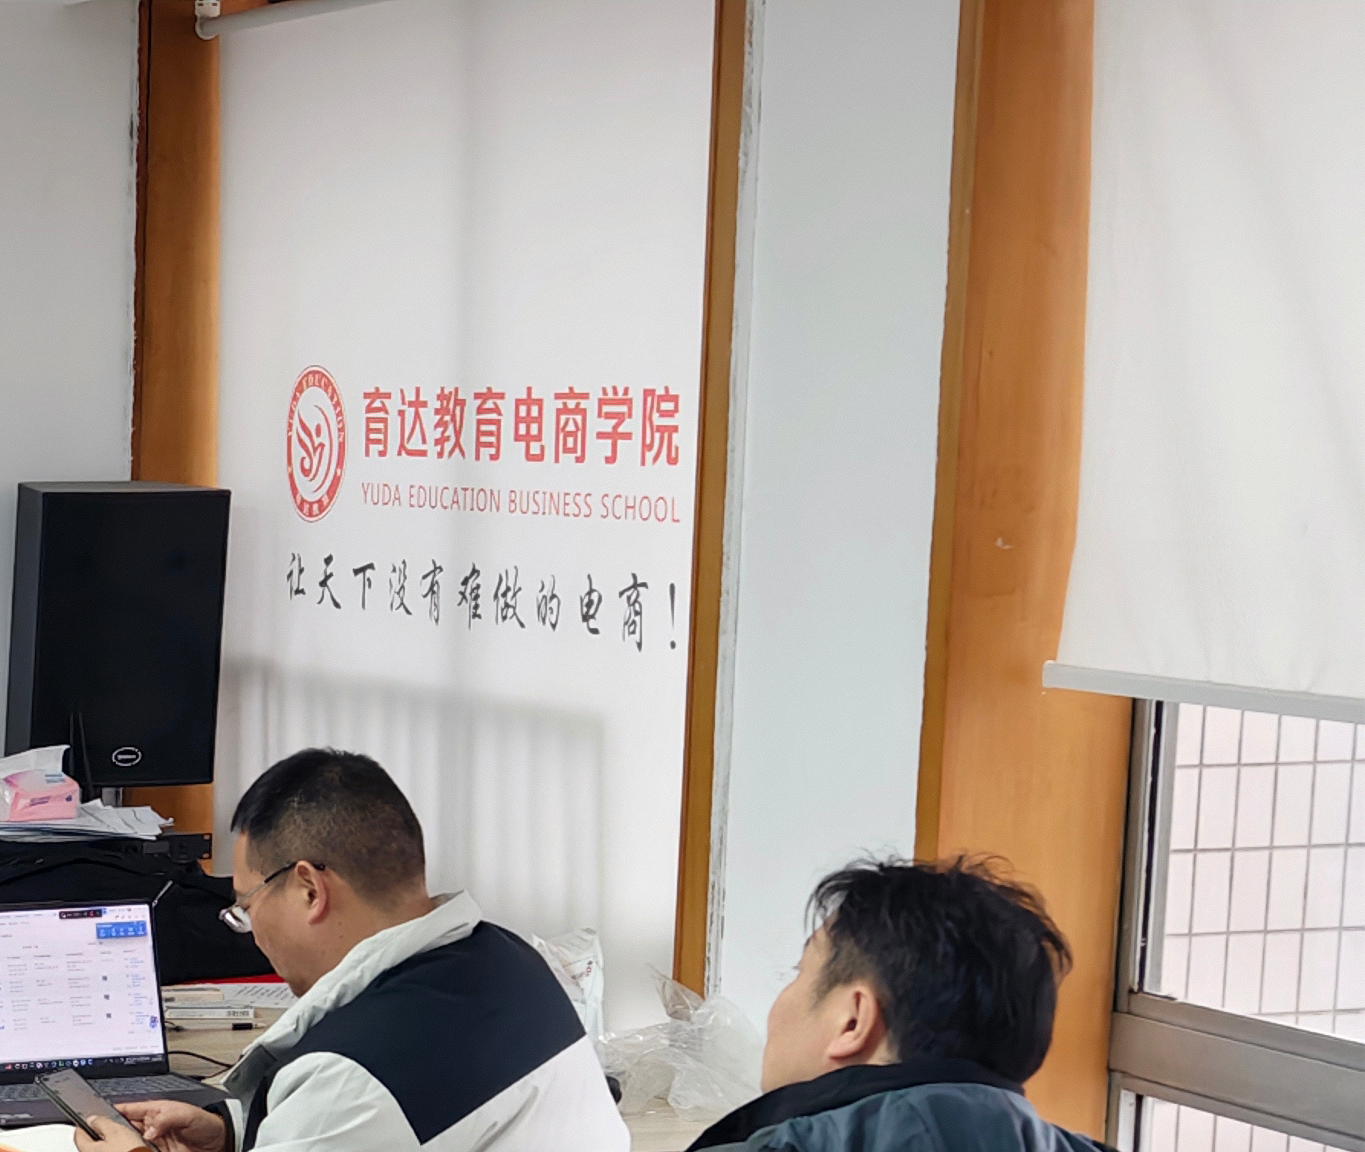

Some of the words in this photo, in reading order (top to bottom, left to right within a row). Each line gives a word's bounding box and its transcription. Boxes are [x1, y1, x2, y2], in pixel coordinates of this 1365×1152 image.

[362, 386, 680, 467] 育达教育电商学院
[362, 482, 402, 507] YUDA
[409, 484, 500, 513] EDUCATION
[509, 489, 593, 519] BUSINESS
[600, 493, 680, 523] SCHOOL
